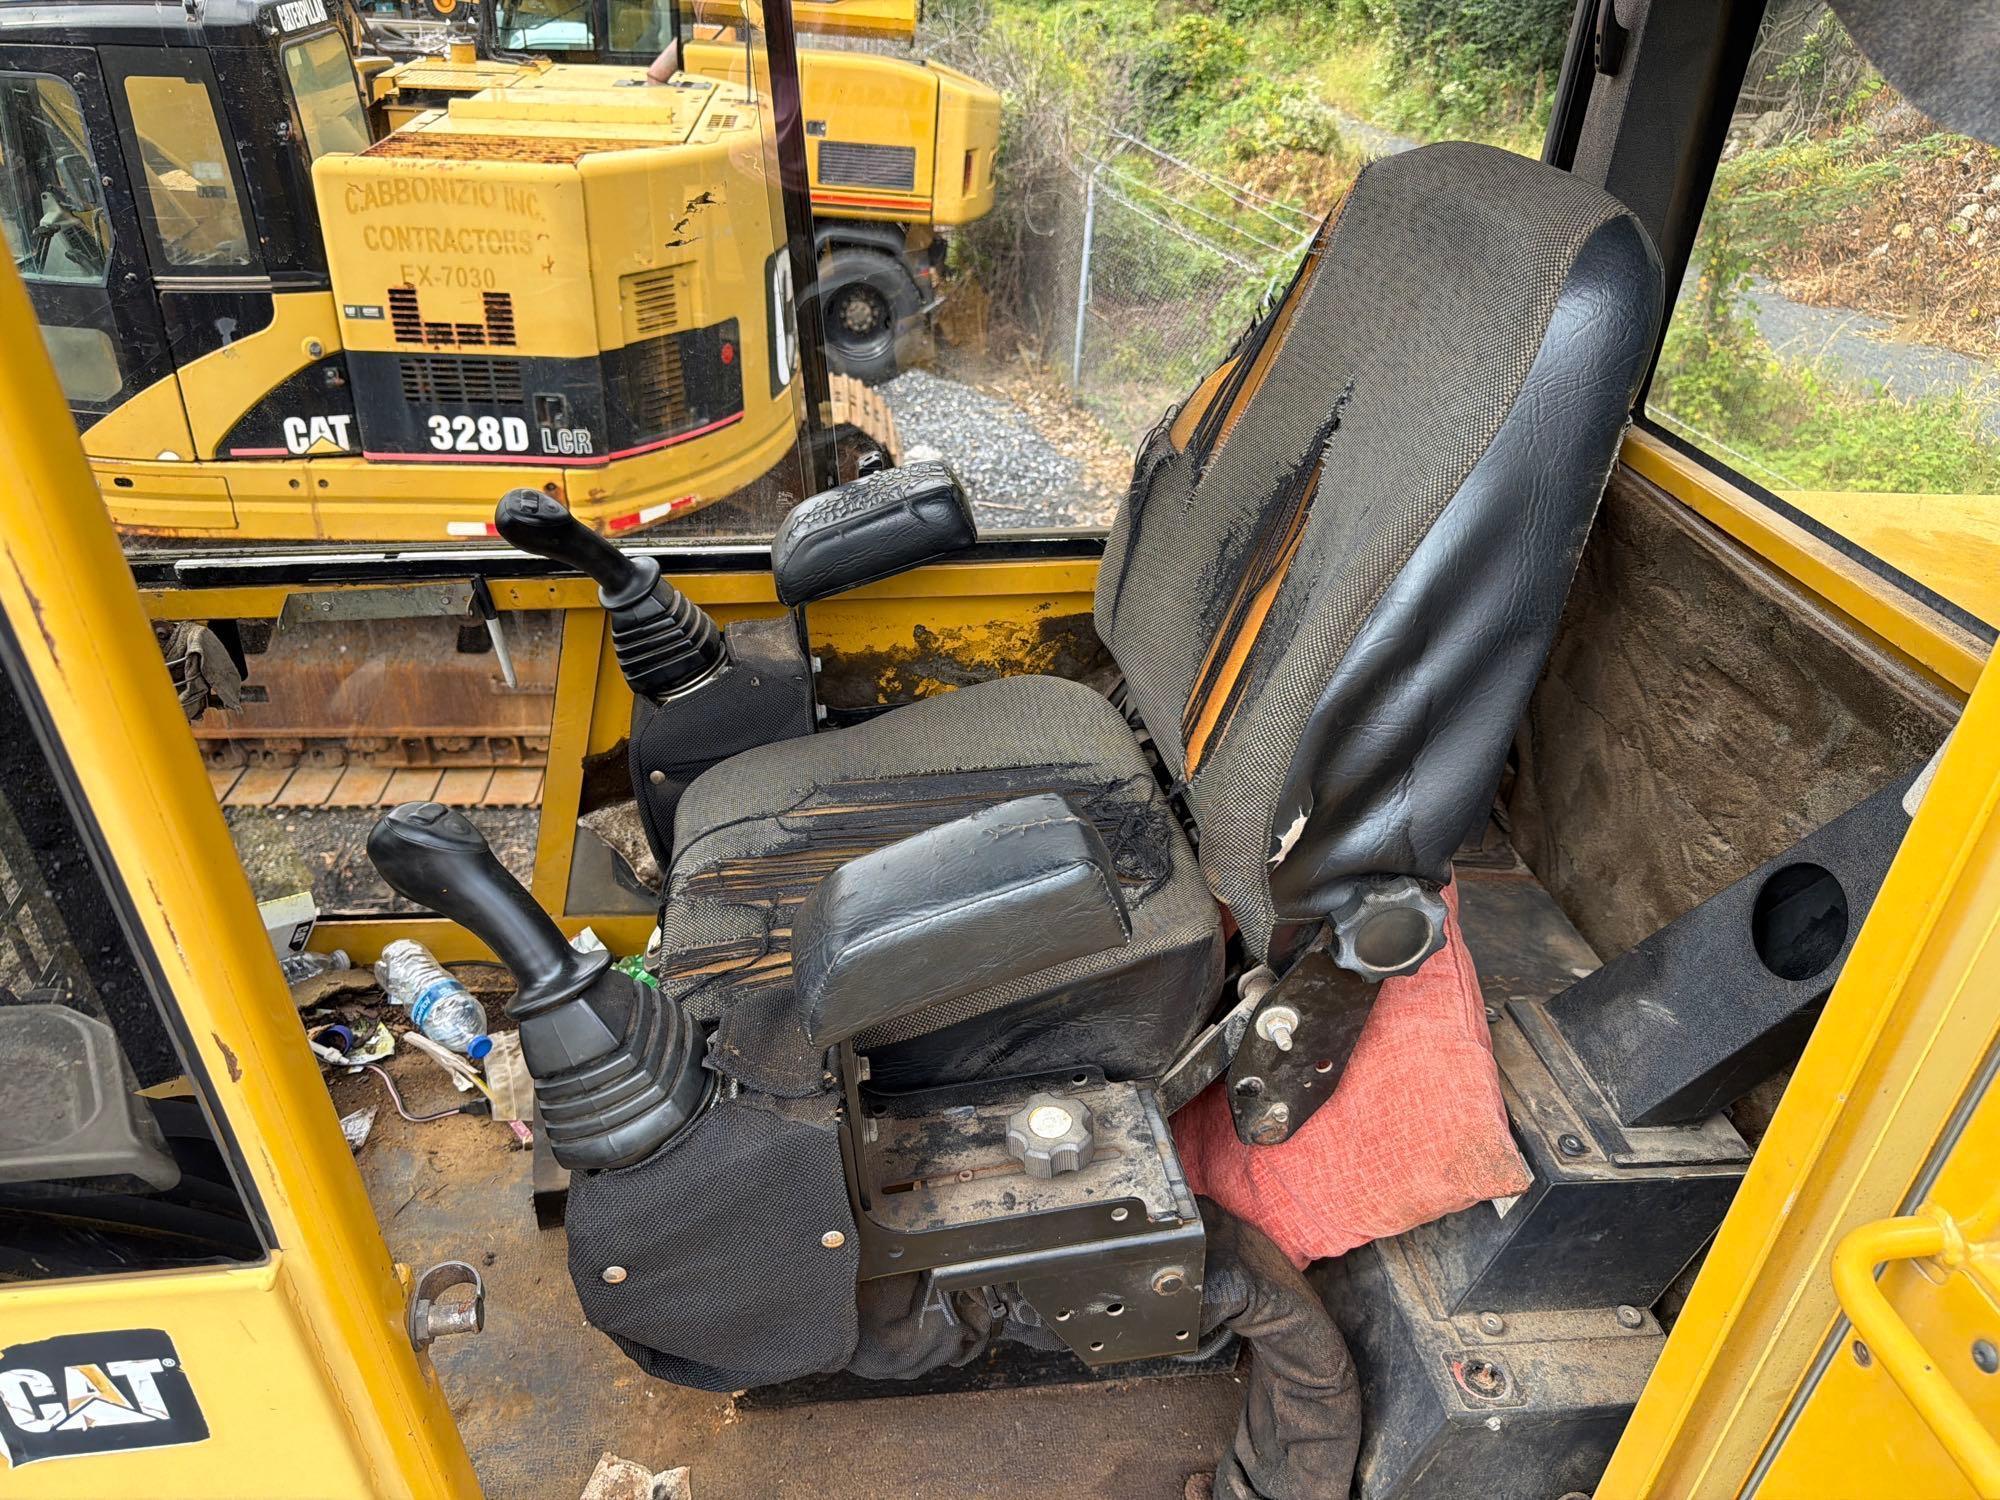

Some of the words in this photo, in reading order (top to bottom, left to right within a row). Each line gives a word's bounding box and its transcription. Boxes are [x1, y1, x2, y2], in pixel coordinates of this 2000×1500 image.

[276, 0, 328, 32] CATERPILLAR
[362, 225, 534, 255] CONTRACTORS
[399, 264, 497, 288] EX-7030
[283, 415, 351, 455] CAT
[427, 414, 530, 452] 328D
[539, 427, 594, 454] LCR
[292, 925, 310, 943] CAT
[0, 1359, 171, 1433] CAT
